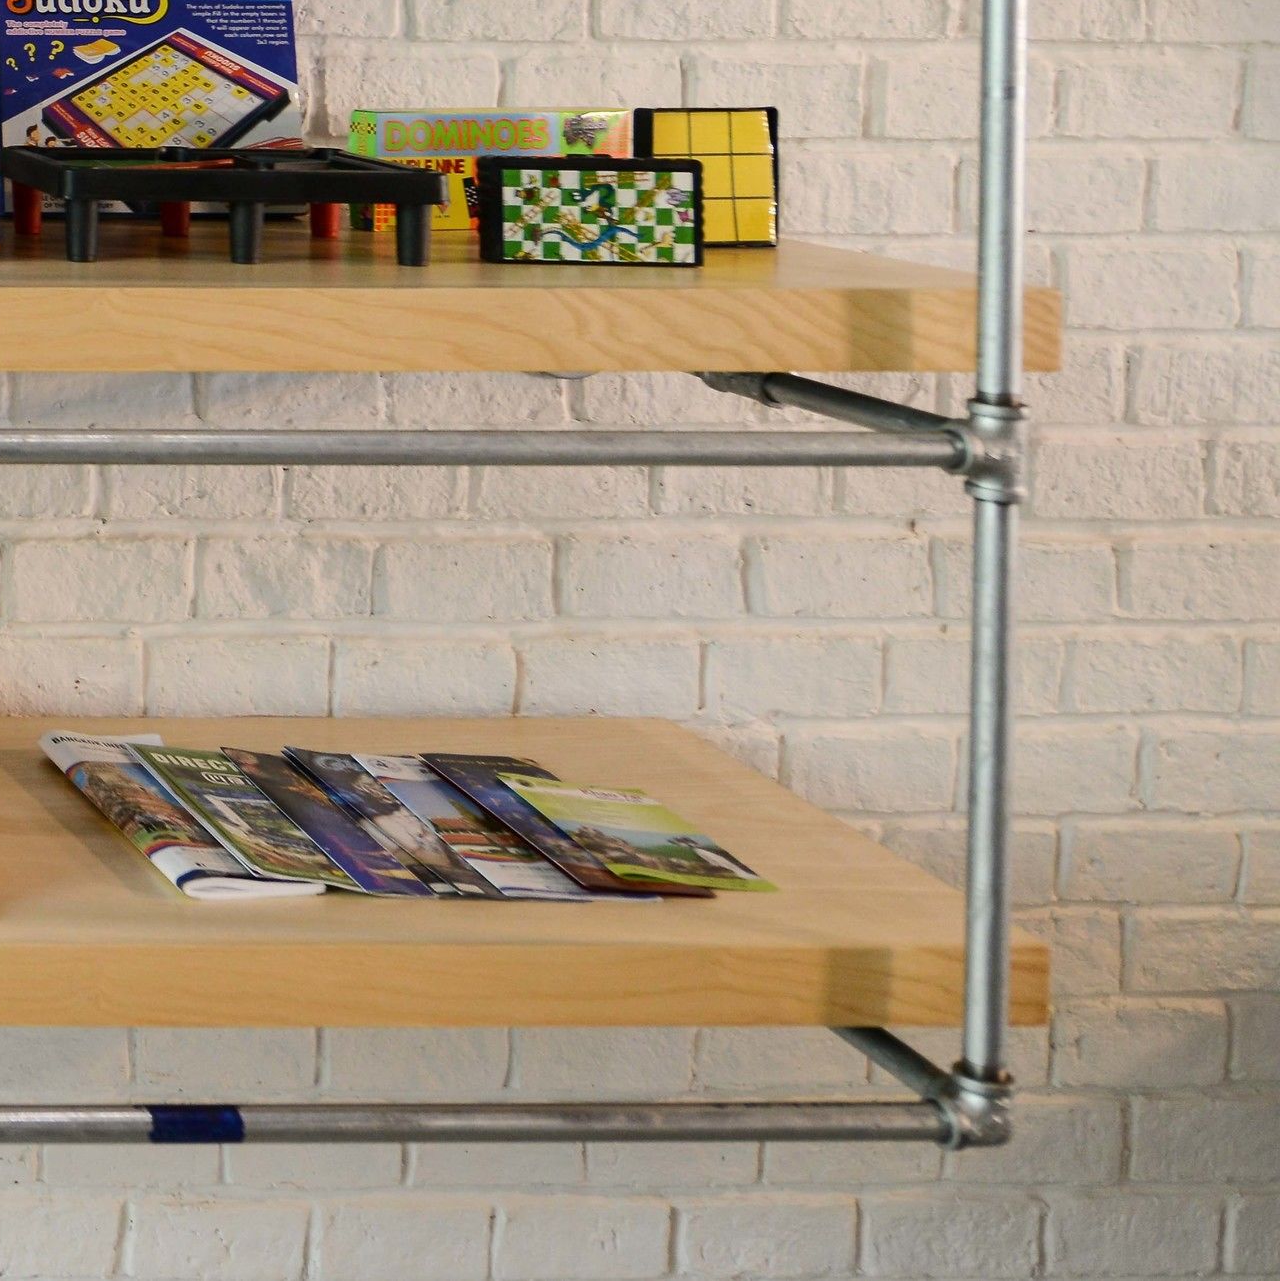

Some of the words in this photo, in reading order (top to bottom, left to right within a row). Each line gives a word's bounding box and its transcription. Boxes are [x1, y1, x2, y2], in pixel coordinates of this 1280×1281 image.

[5, 20, 23, 28] The
[23, 20, 69, 30] completely
[102, 29, 127, 37] game
[383, 119, 550, 153] DOMINOES
[437, 158, 466, 175] NINE
